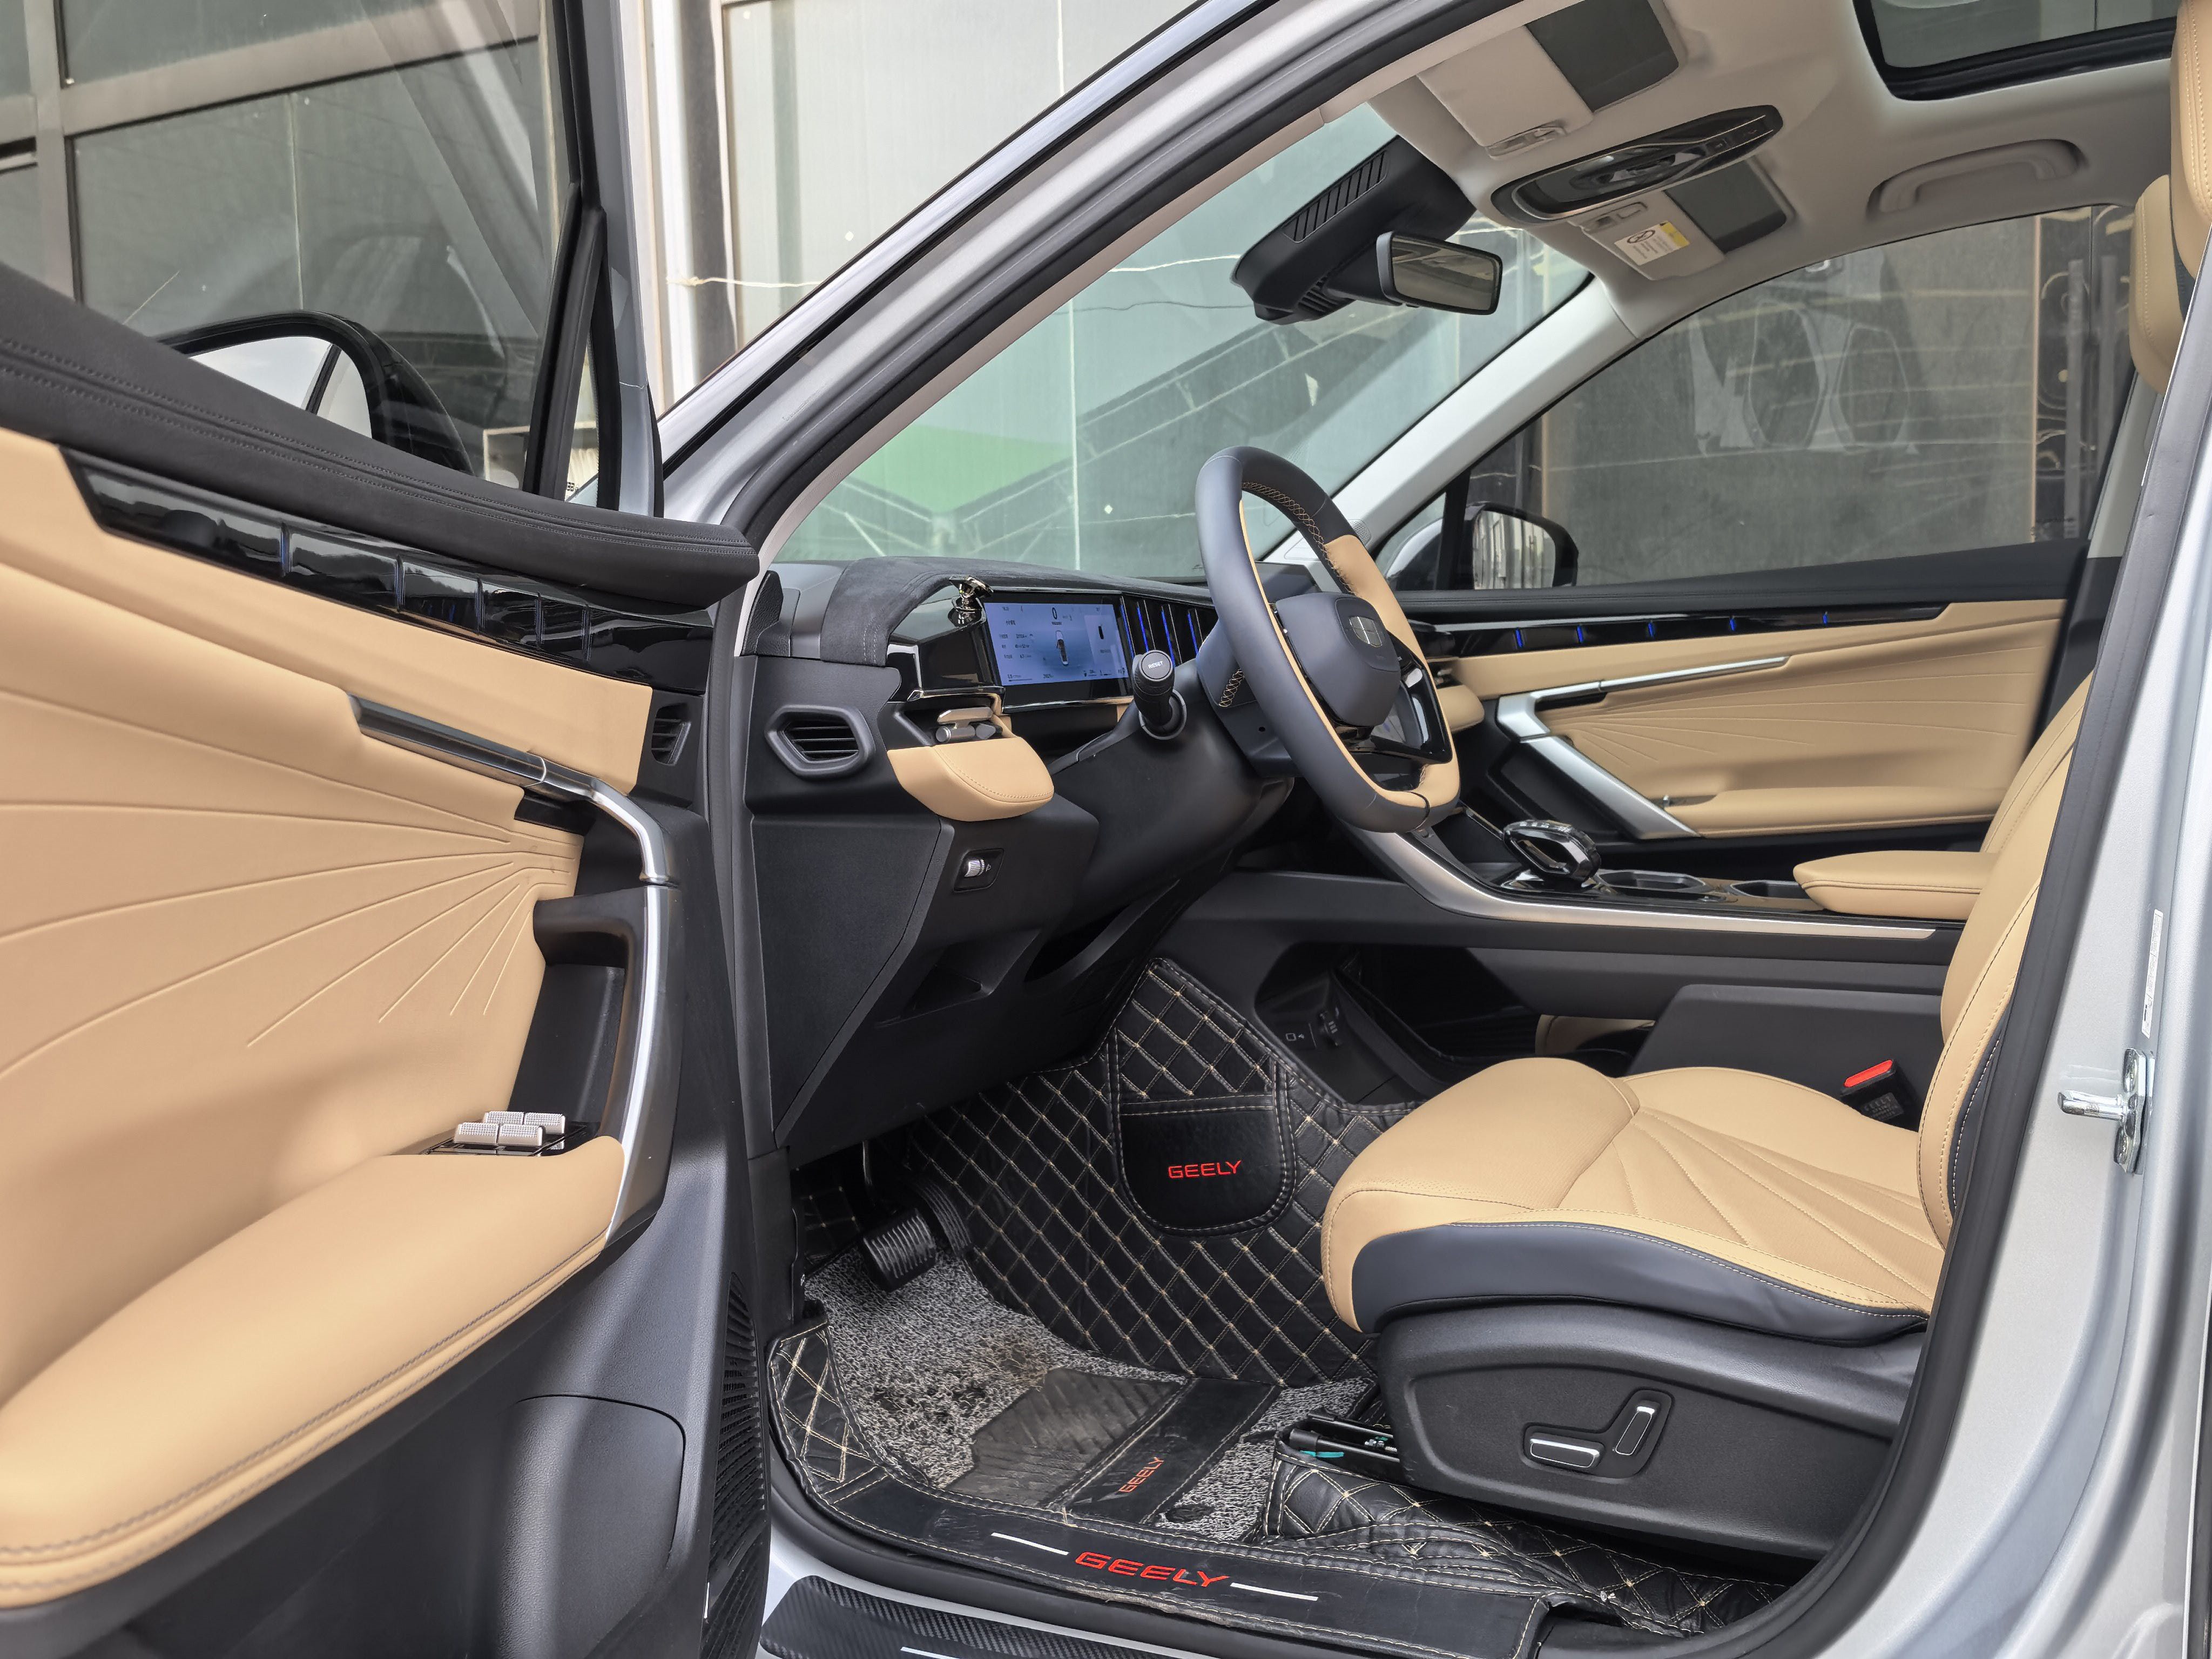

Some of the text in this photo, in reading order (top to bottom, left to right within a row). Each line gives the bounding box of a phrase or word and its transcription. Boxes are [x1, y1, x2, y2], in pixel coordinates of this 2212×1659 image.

[1148, 660, 1163, 669] RESET
[1168, 1160, 1241, 1179] GEELY
[1118, 1456, 1164, 1493] GEELY
[1075, 1552, 1230, 1587] GEELY
